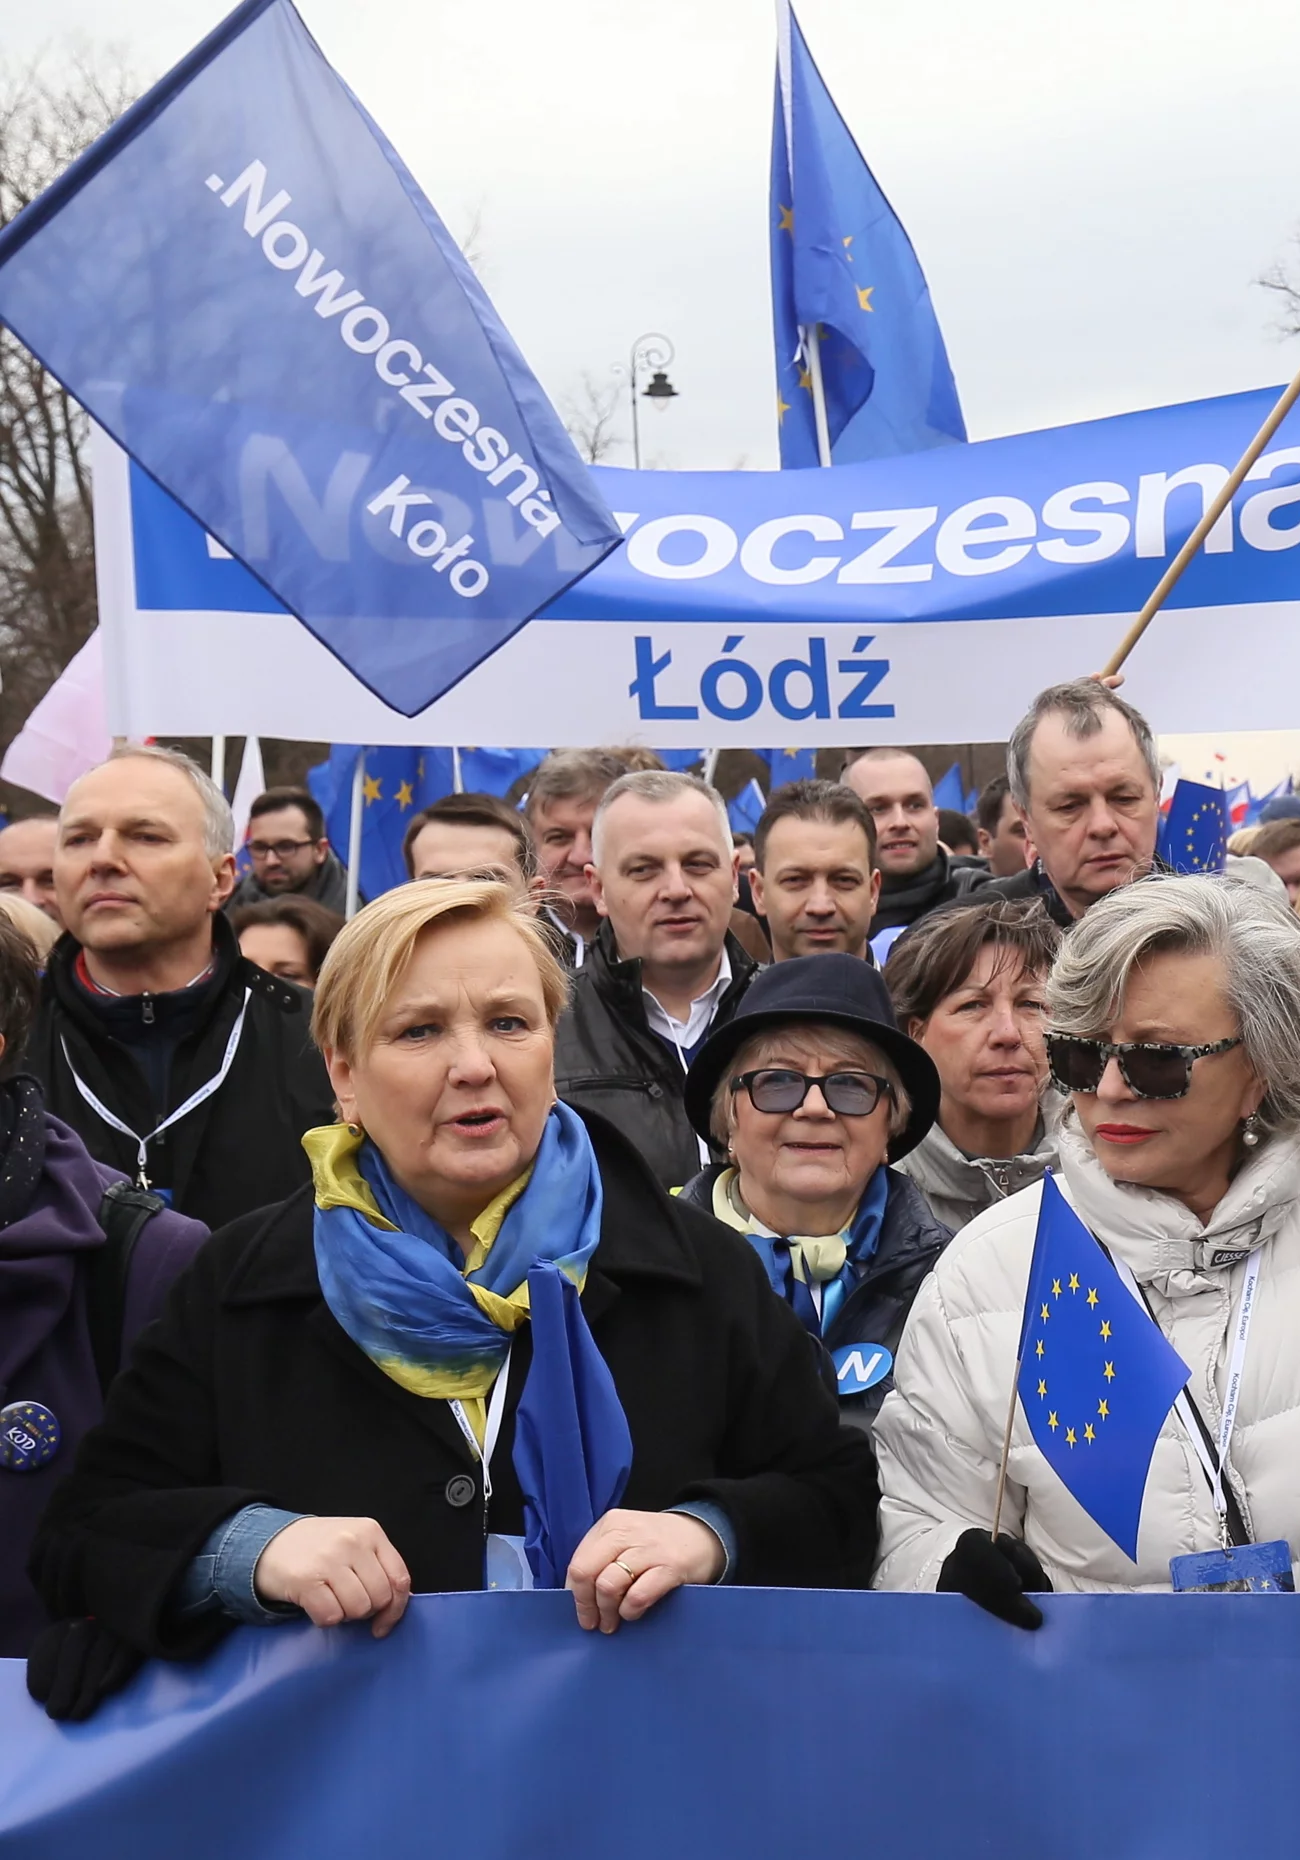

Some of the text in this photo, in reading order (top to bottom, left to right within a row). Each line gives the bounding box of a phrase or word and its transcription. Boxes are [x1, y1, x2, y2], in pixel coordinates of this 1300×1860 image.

[205, 159, 565, 537] .Nowoczesna
[366, 474, 489, 598] Koło
[628, 634, 896, 721] Łódź
[1229, 1372, 1240, 1403] Kocham
[6, 1427, 36, 1450] KOD
